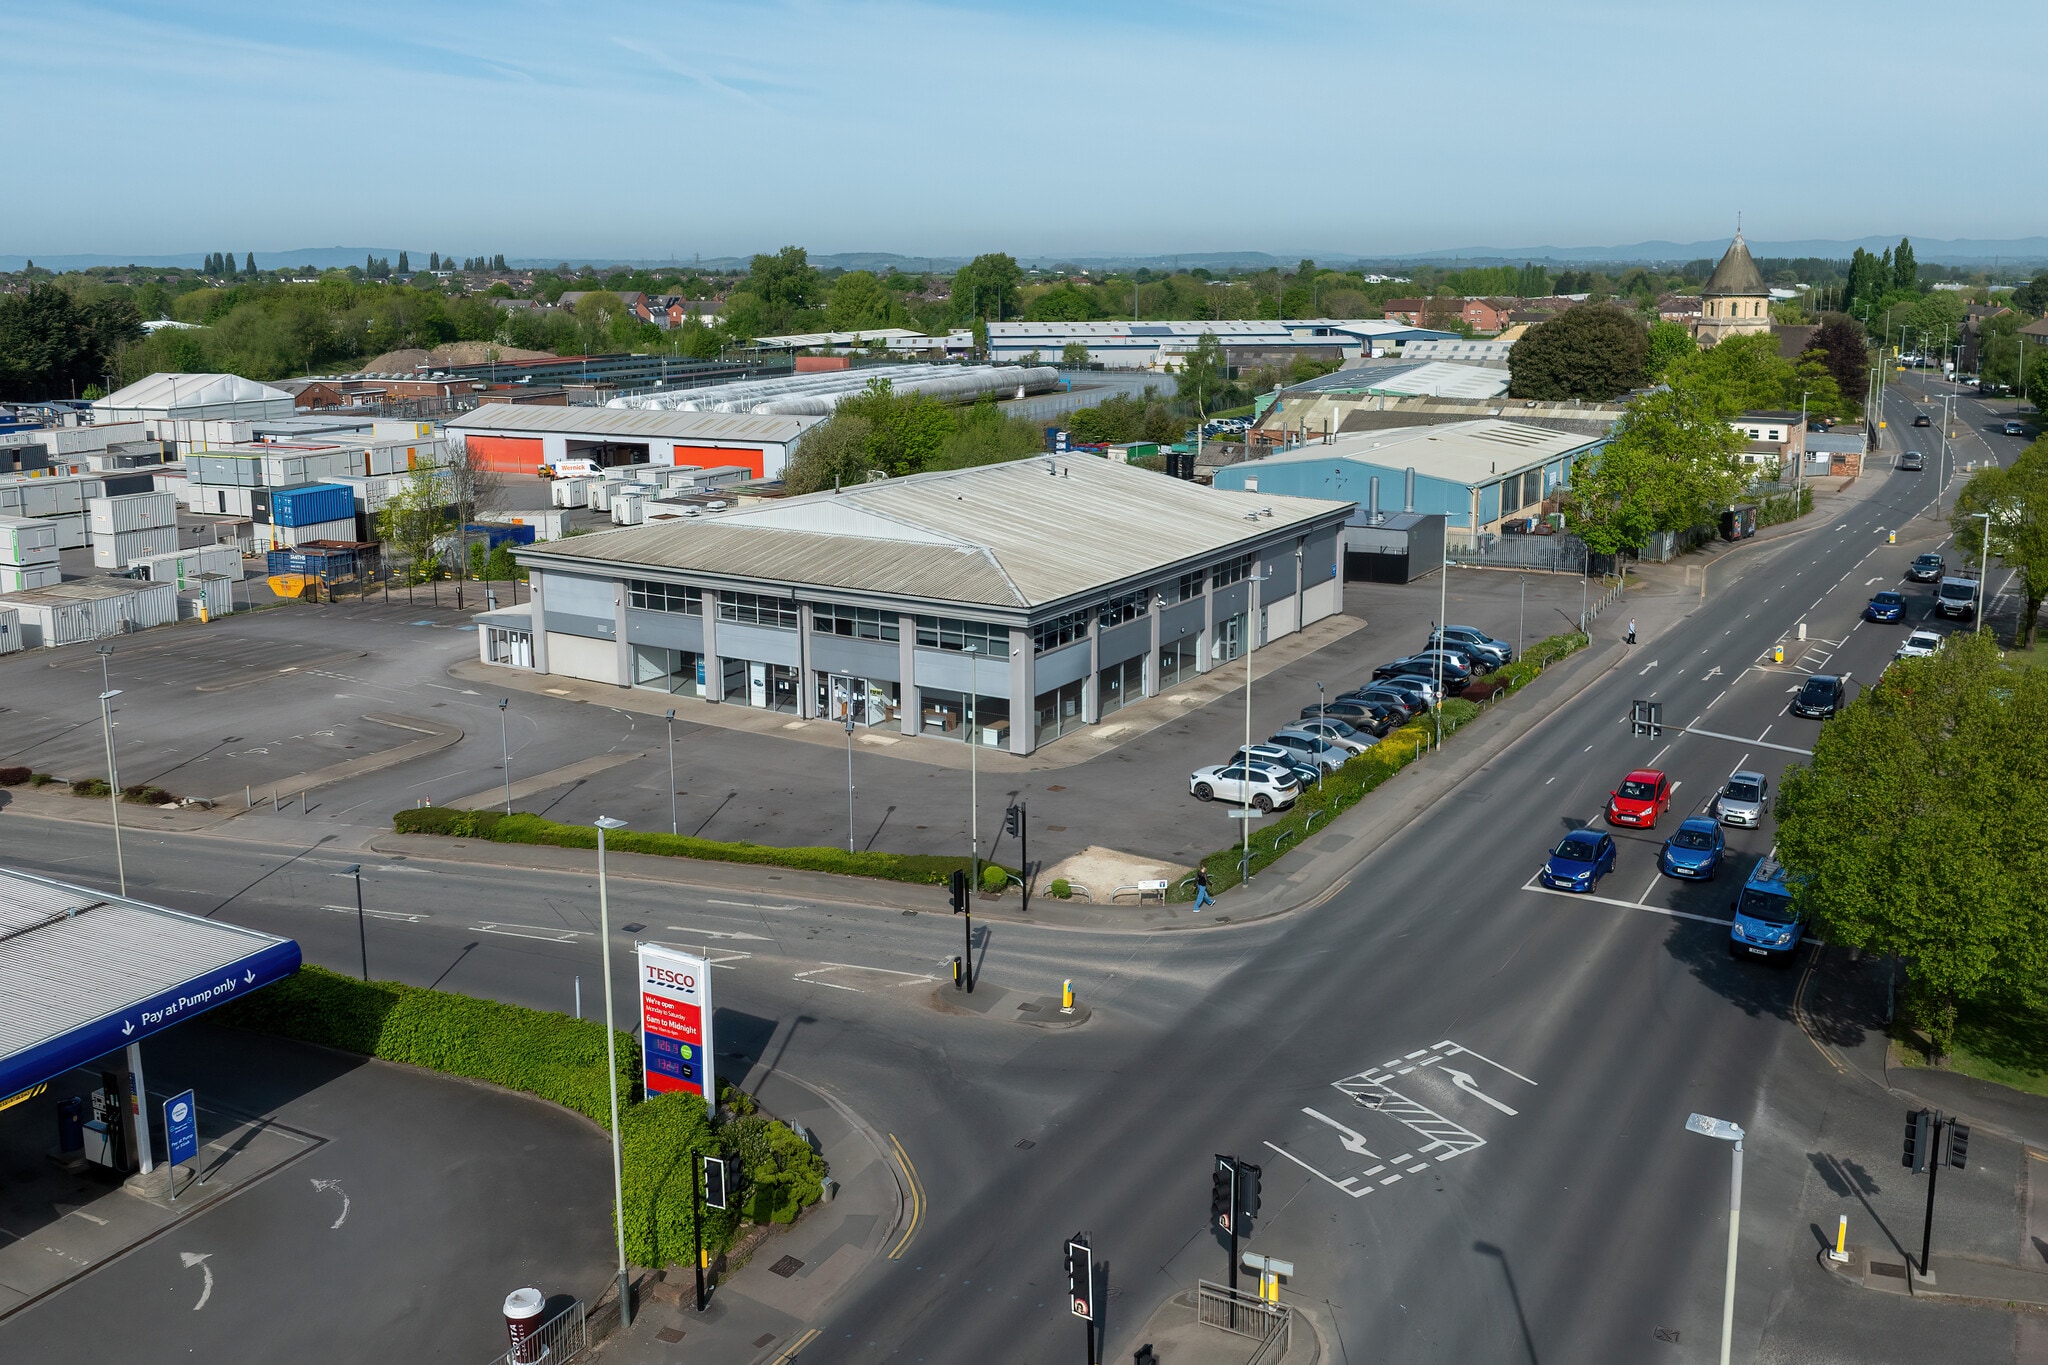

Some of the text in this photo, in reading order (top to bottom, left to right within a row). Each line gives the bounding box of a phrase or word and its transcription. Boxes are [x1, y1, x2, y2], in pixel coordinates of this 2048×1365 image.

[646, 965, 695, 988] TESCO
[141, 978, 237, 1026] Pay at Pump only
[645, 996, 675, 1010] We're open
[645, 1005, 663, 1015] Monday
[668, 1010, 686, 1021] Saturday
[646, 1014, 697, 1035] 6am to Midnight
[510, 1324, 520, 1356] COSTA
